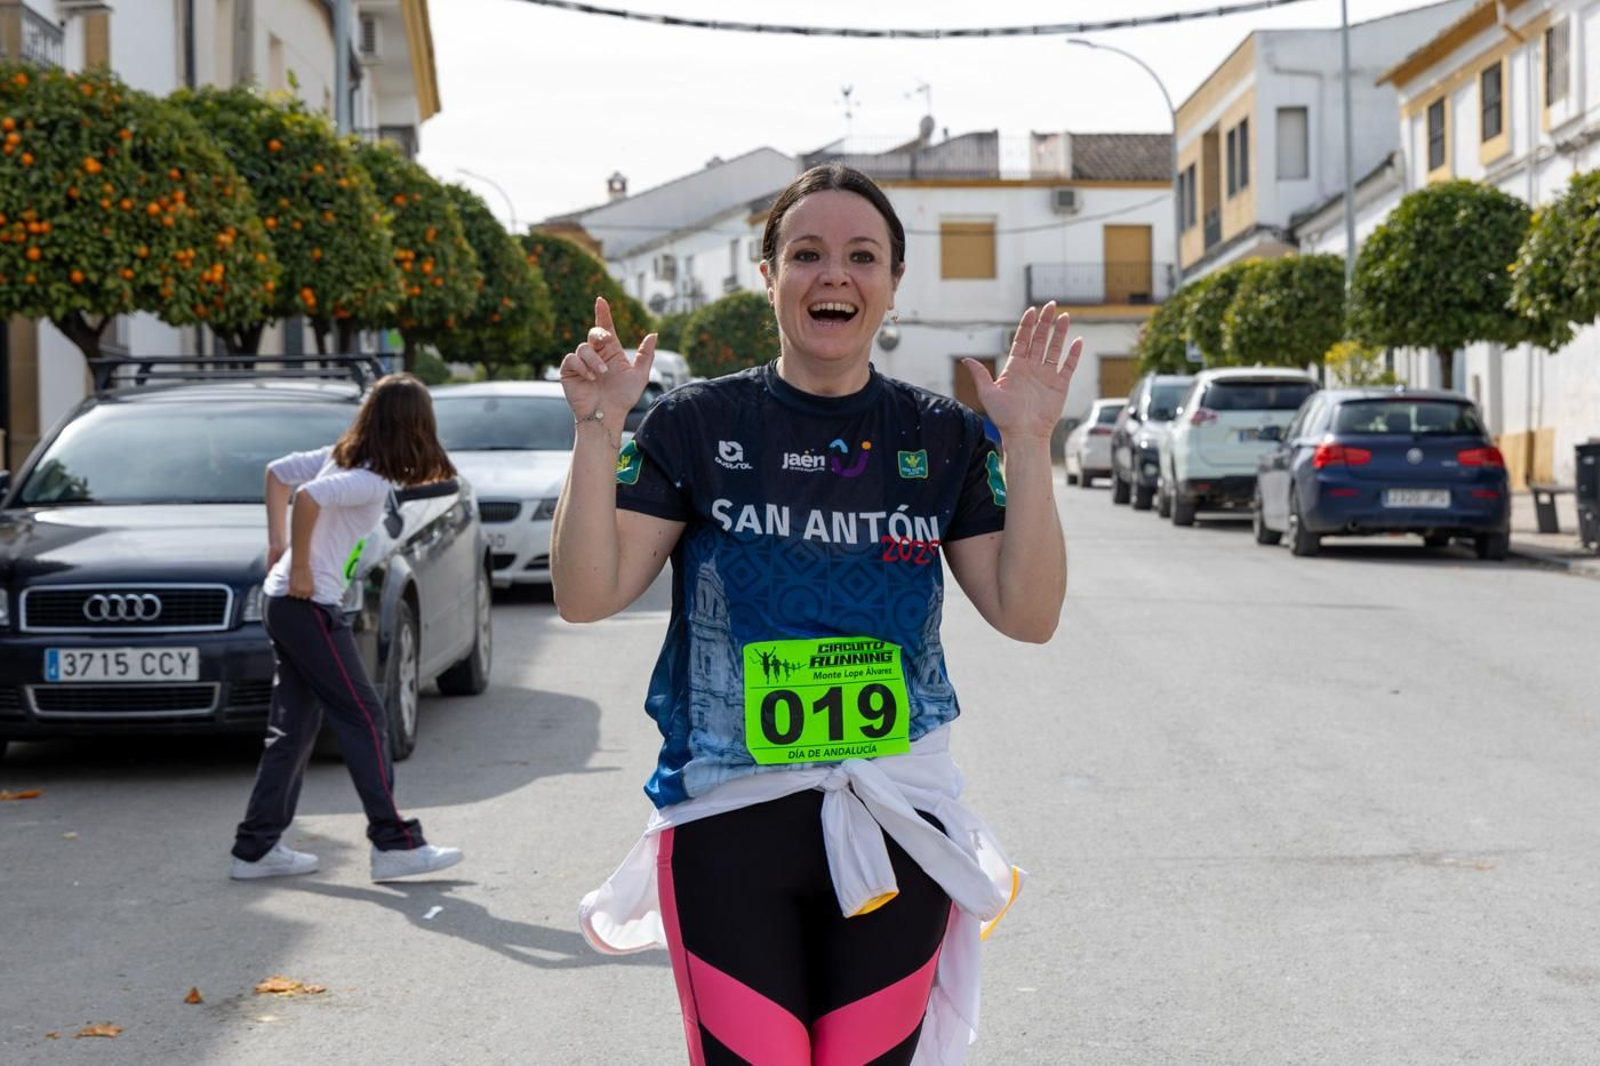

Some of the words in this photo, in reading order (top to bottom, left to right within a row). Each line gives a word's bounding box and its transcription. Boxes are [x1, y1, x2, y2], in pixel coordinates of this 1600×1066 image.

[711, 498, 790, 537] SAN
[803, 504, 941, 547] ANTÓN
[817, 641, 885, 654] CIRCUITO
[63, 652, 130, 677] 3715
[140, 652, 191, 677] CCY
[809, 651, 893, 668] RUNNING
[813, 671, 842, 680] Monte
[844, 670, 864, 680] Lope
[865, 666, 892, 677] Álvarez
[760, 682, 897, 746] 019
[788, 748, 805, 760] DÍA
[808, 749, 821, 758] DE
[823, 744, 878, 758] ANDALUCÍA
